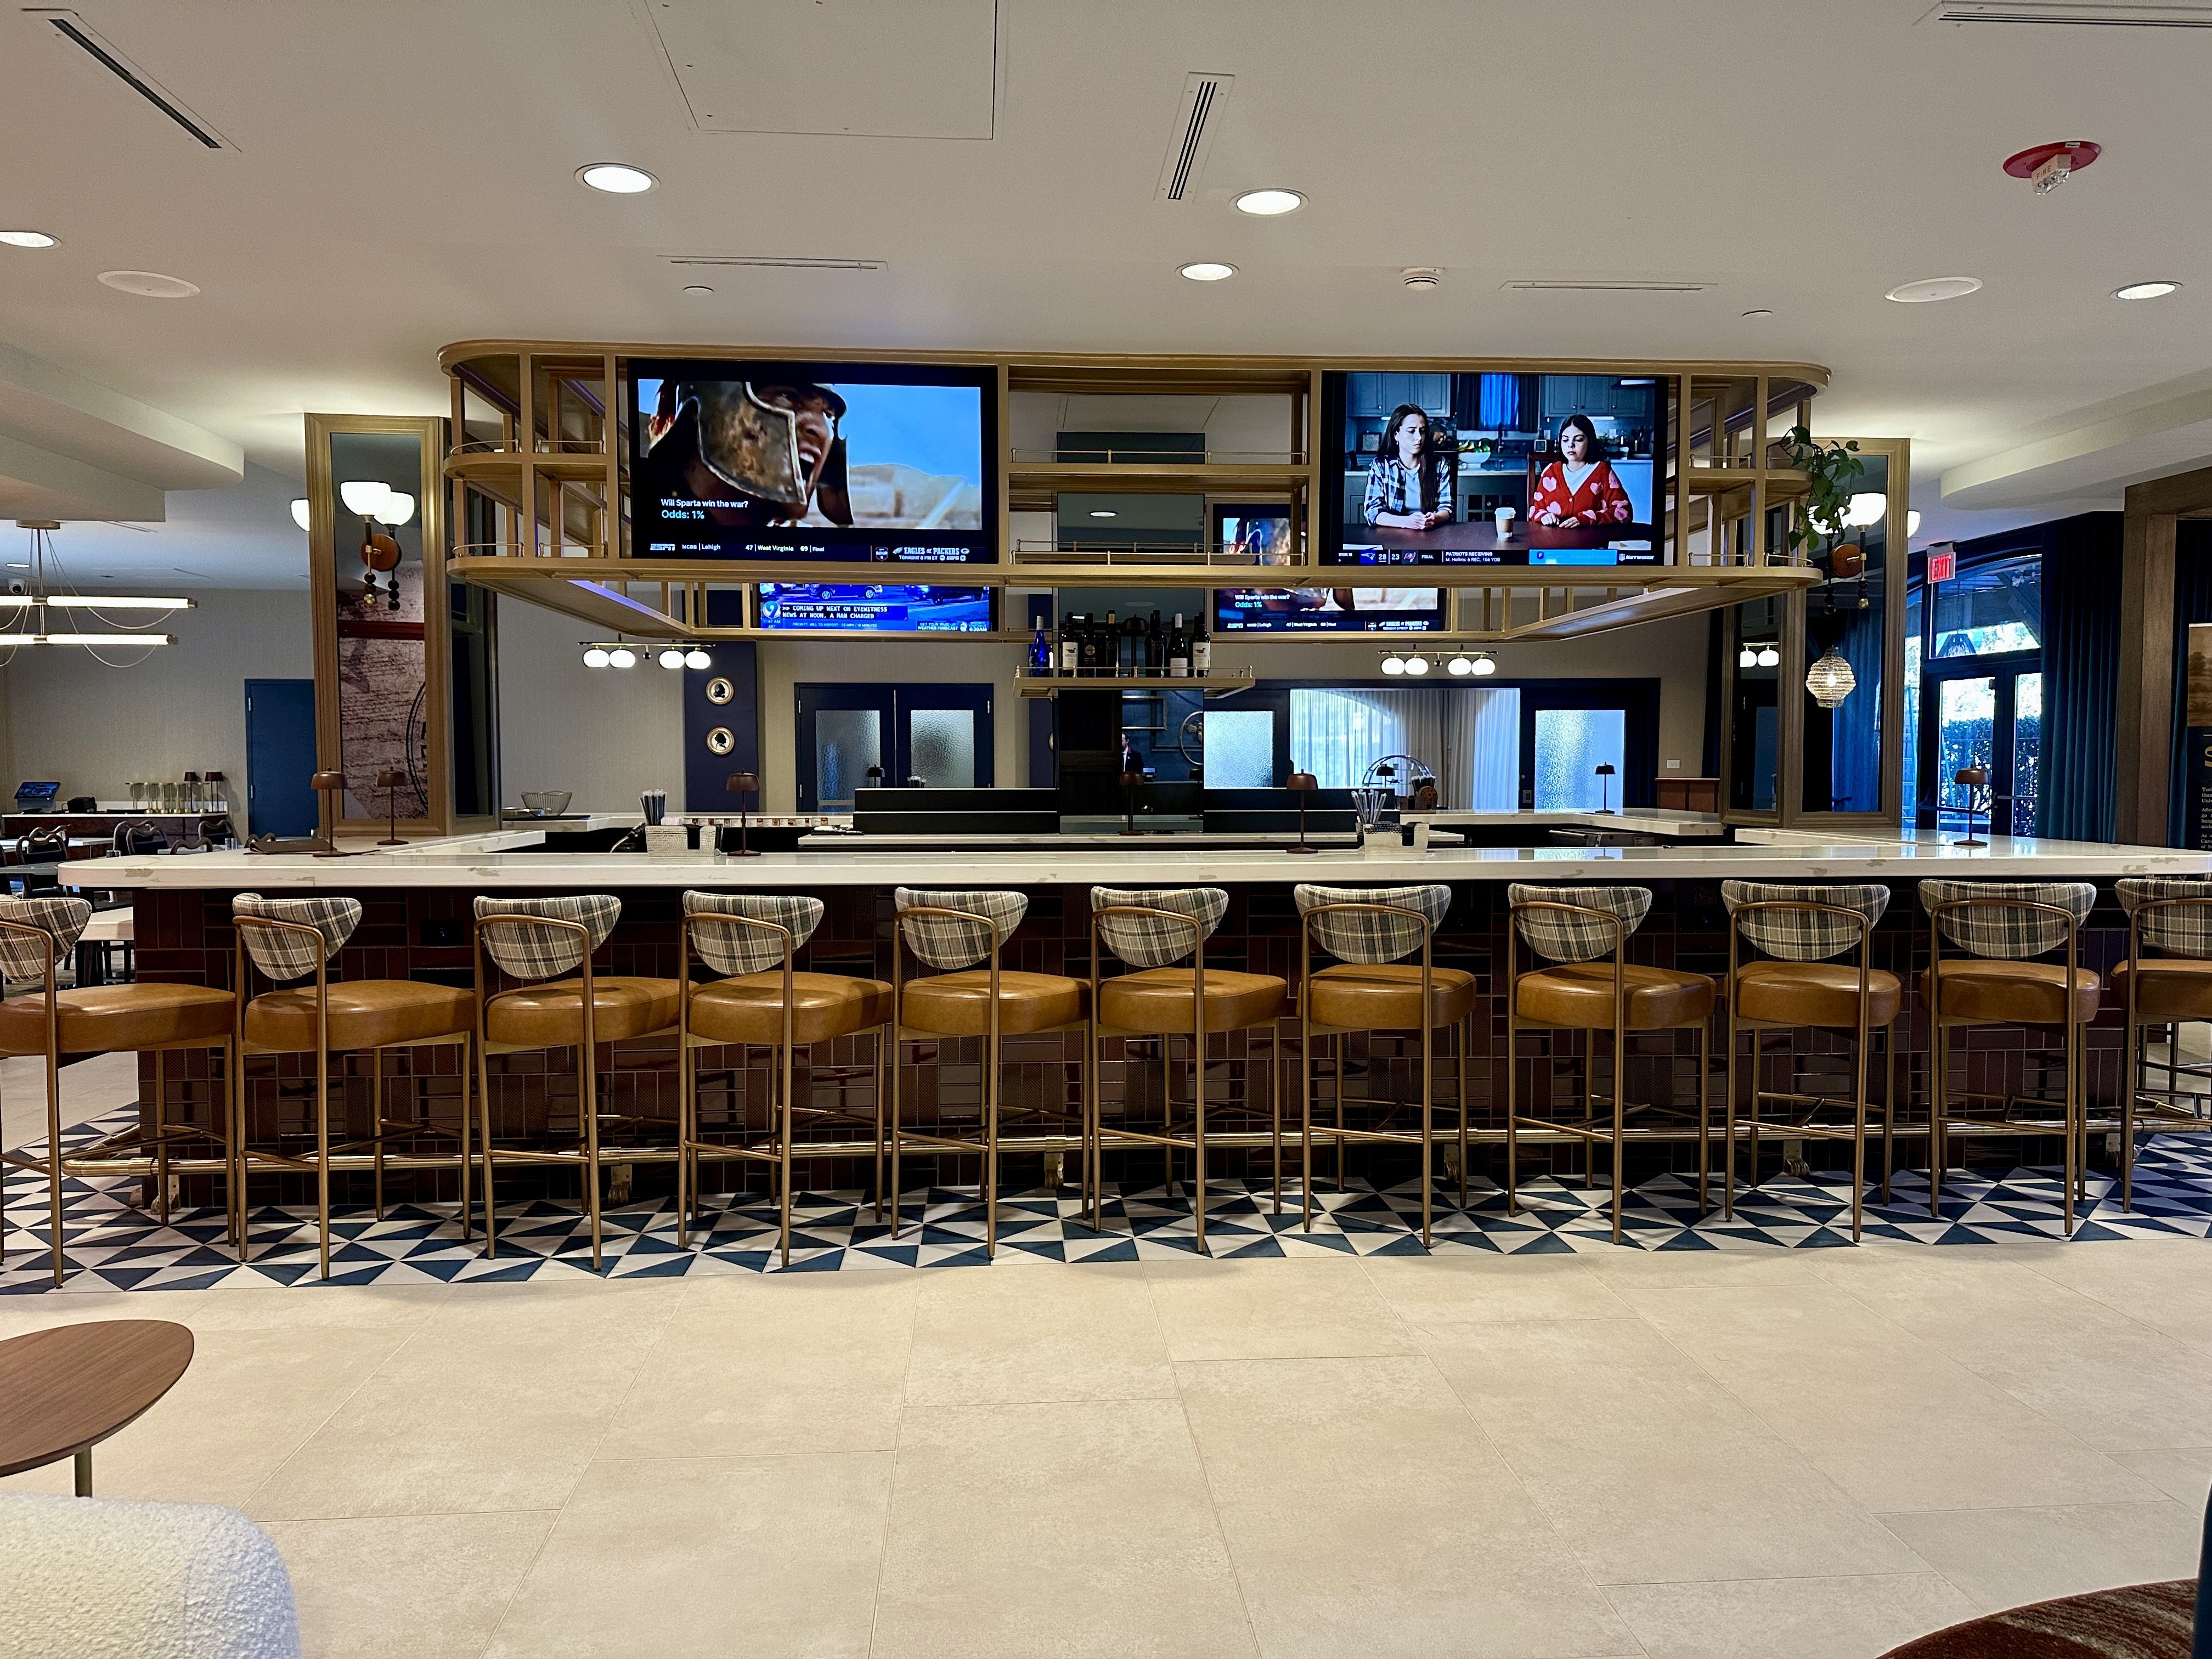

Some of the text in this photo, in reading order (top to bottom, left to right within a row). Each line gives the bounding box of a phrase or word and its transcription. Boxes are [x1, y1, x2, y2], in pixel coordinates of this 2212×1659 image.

[2036, 165, 2051, 180] FIRE
[676, 500, 701, 508] Sparta
[661, 510, 705, 520] Odds: 1%
[1932, 555, 1952, 580] EXIT
